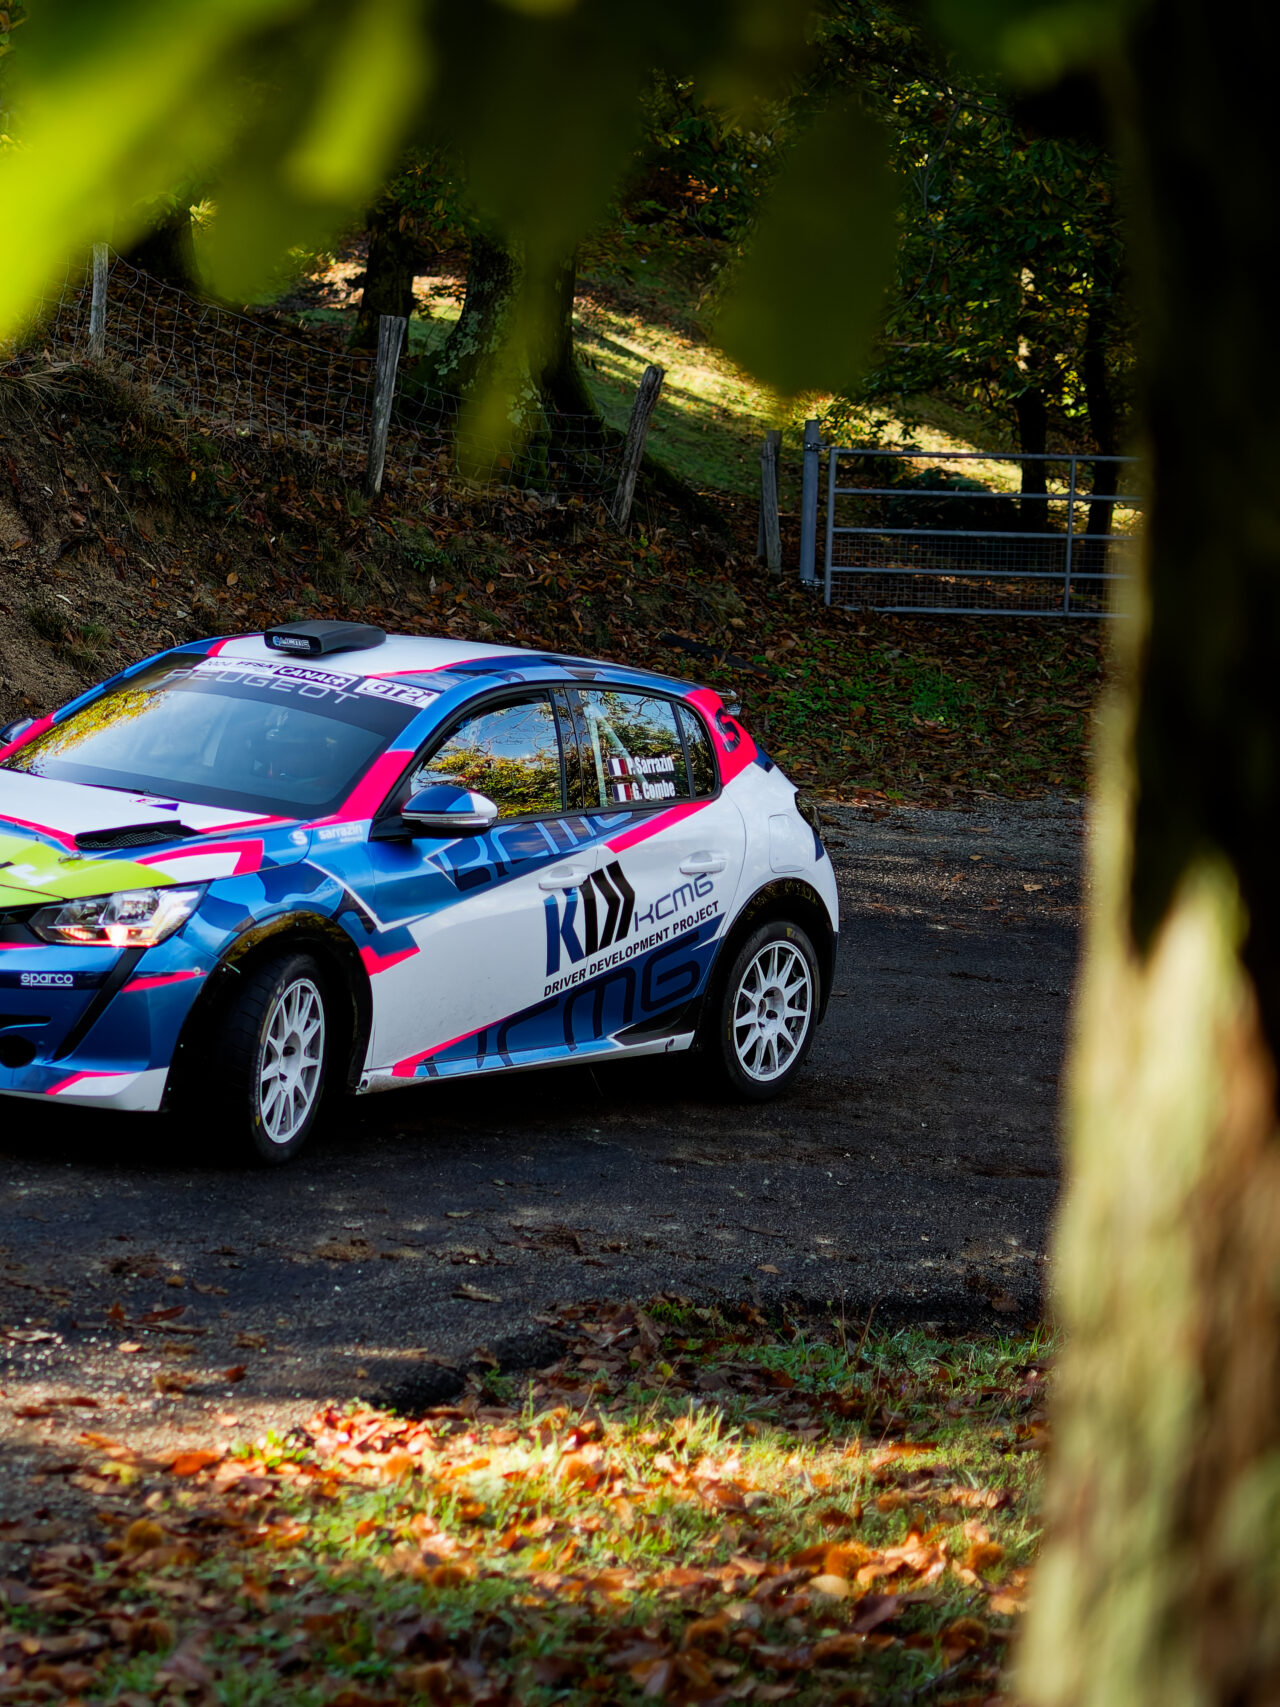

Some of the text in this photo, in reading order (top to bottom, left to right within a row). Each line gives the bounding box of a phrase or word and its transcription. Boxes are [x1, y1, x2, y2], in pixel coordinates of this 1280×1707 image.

[163, 668, 360, 704] PEUGEOT
[278, 666, 347, 687] CANAL+
[631, 779, 676, 800] G. Combe
[318, 822, 363, 841] sarrazin
[634, 872, 714, 933] KCMG
[543, 899, 720, 998] DRIVER DEVELOPMENT PROJECT
[20, 972, 74, 987] sparco
